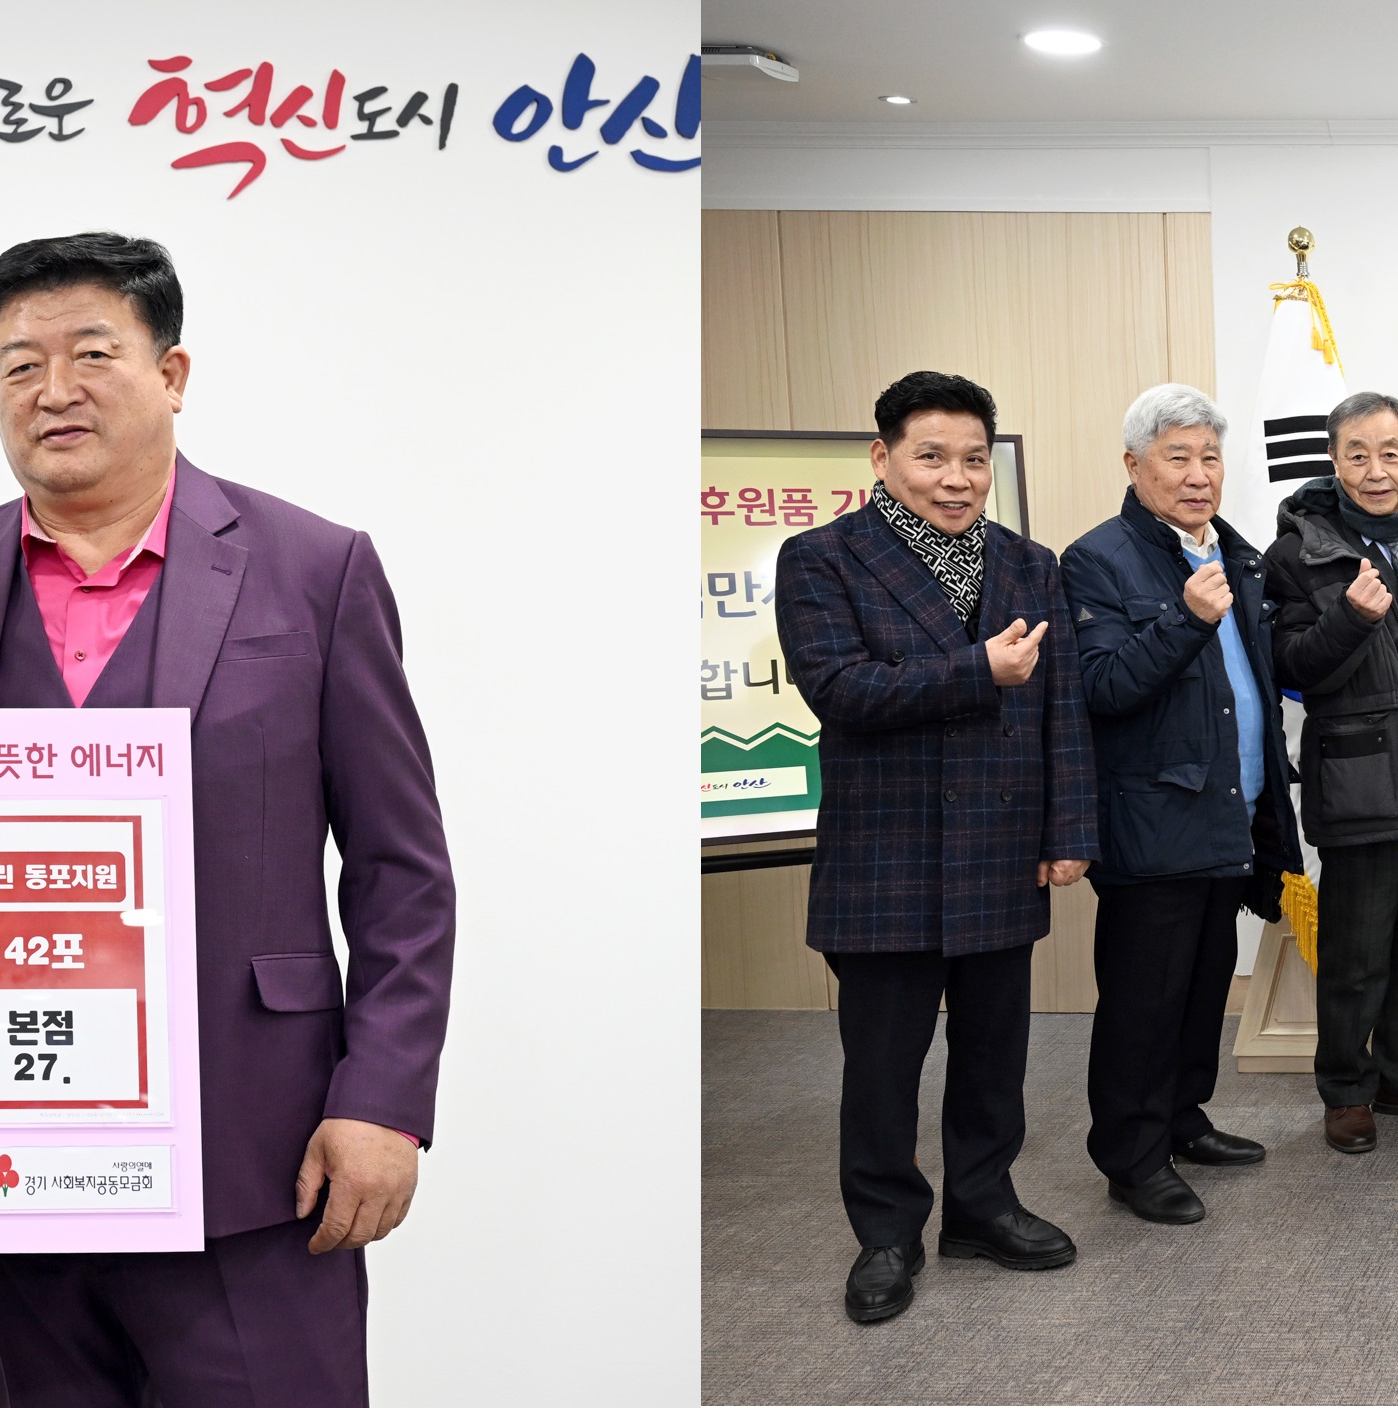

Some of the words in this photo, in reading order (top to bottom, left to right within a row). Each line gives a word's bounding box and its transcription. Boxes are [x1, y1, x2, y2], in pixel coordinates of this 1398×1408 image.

[127, 54, 459, 201] 혁신도시
[492, 52, 701, 173] 안산
[701, 486, 818, 527] 후원품
[831, 489, 876, 518] 기
[701, 659, 796, 701] 합니
[70, 742, 165, 777] 에너지
[733, 777, 771, 790] 안산
[24, 863, 118, 890] 동포지원
[7, 1009, 75, 1047] 본점
[13, 1052, 72, 1085] 27.
[24, 1175, 47, 1196] 경기
[51, 1174, 153, 1196] 사회복지공동모금회
